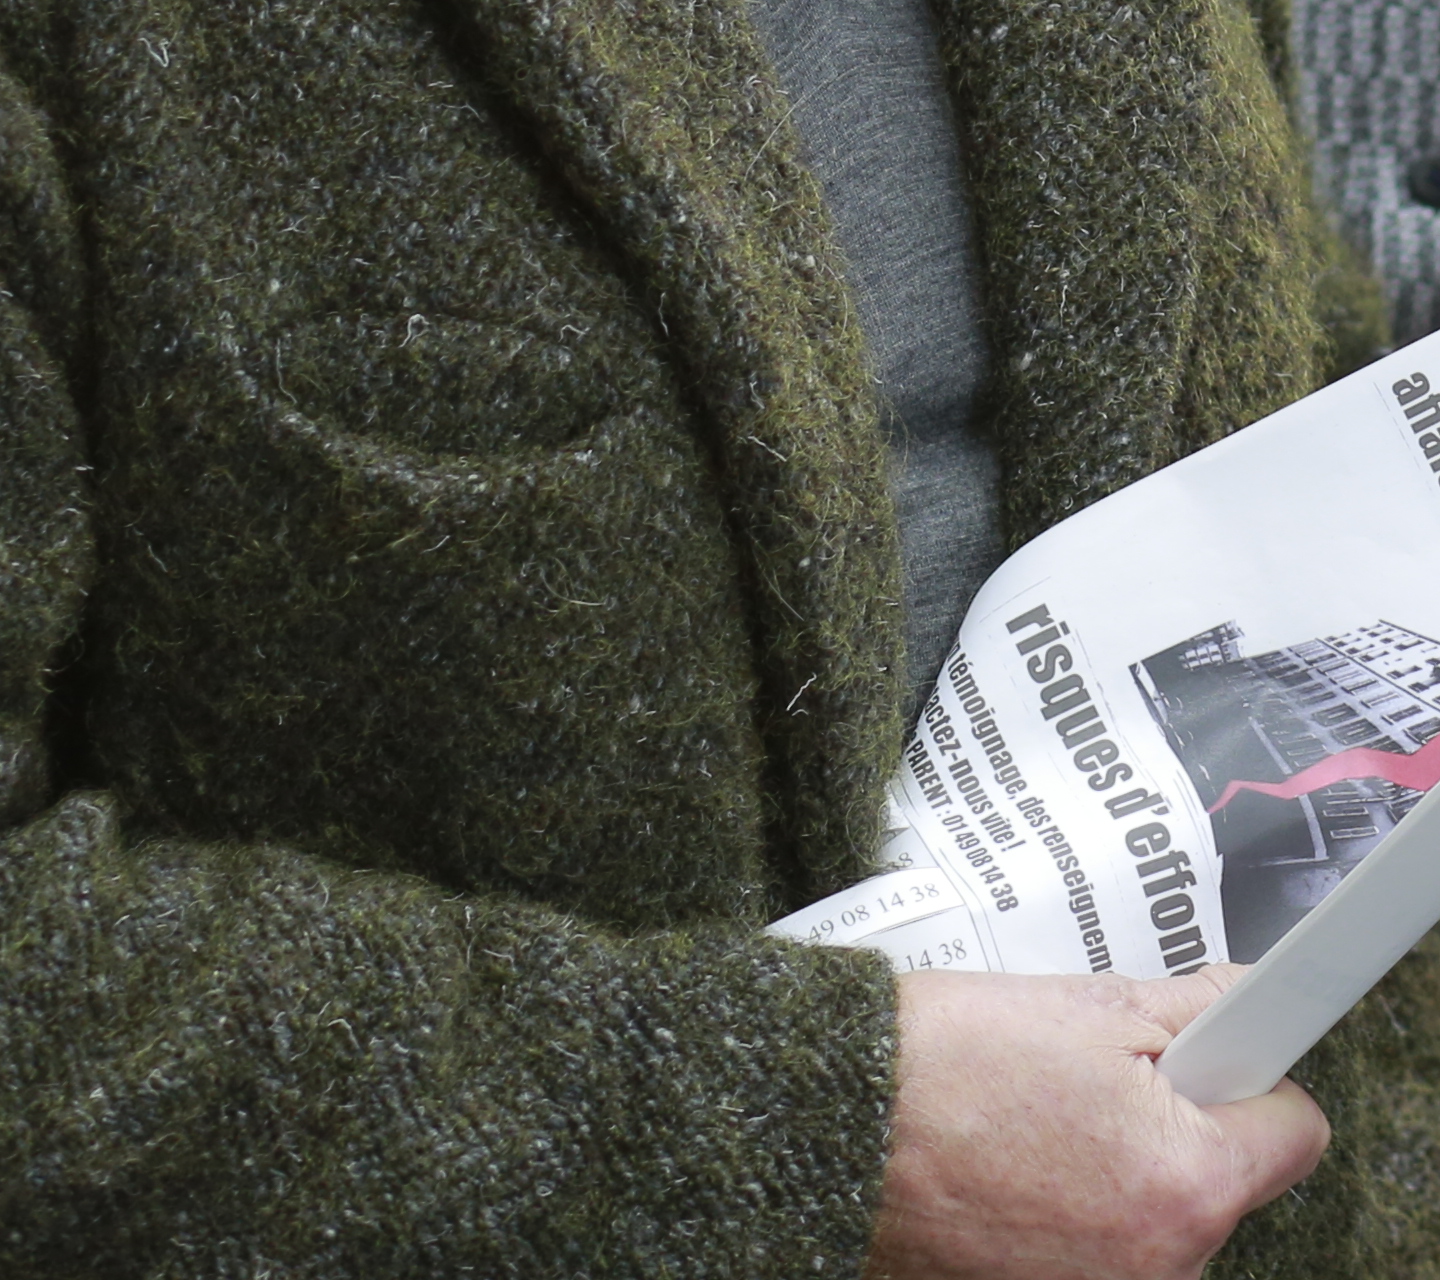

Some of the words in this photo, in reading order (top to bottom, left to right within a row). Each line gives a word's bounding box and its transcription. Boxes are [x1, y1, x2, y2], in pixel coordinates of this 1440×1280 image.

[906, 738, 953, 810] PARENT
[924, 686, 994, 815] actez-nous
[980, 812, 1015, 844] vite
[1005, 603, 1134, 792] risques
[1105, 787, 1211, 977] d'effon
[941, 814, 969, 833] 01
[948, 652, 1027, 800] témoignage,
[1016, 796, 1052, 828] des
[1037, 825, 1114, 975] renseignem
[954, 831, 981, 850] 49
[965, 847, 993, 867] 08
[979, 865, 1006, 884] 14
[841, 903, 871, 927] 08
[876, 891, 905, 914] 14
[909, 882, 940, 903] 38
[990, 883, 1019, 912] 38
[905, 948, 933, 972] 14
[938, 937, 967, 965] 38
